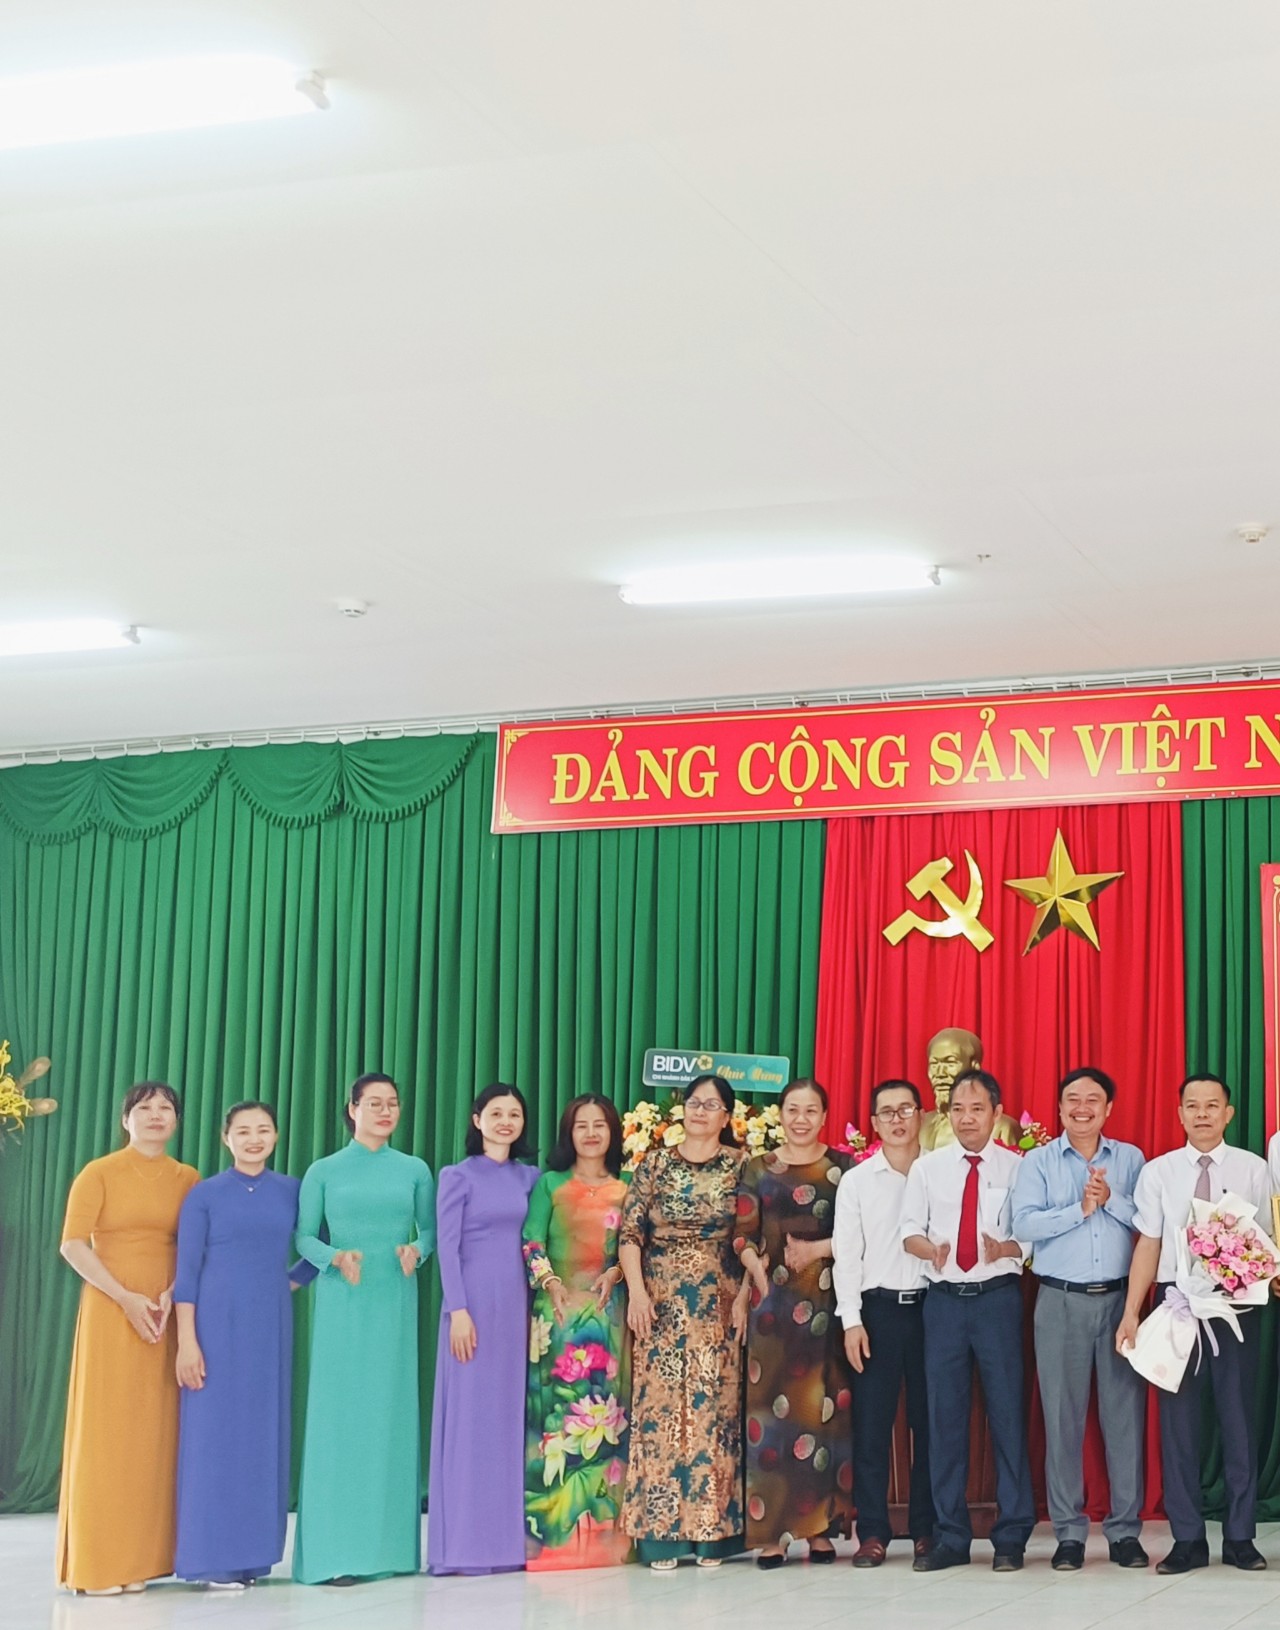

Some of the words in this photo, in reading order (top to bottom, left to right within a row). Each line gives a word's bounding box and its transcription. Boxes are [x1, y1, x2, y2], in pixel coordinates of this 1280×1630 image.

[549, 728, 718, 804] ĐẢNG
[737, 725, 909, 806] CỘNG
[929, 706, 1053, 786] SẢN
[1076, 703, 1226, 788] VIỆT
[652, 1055, 698, 1073] BIDV
